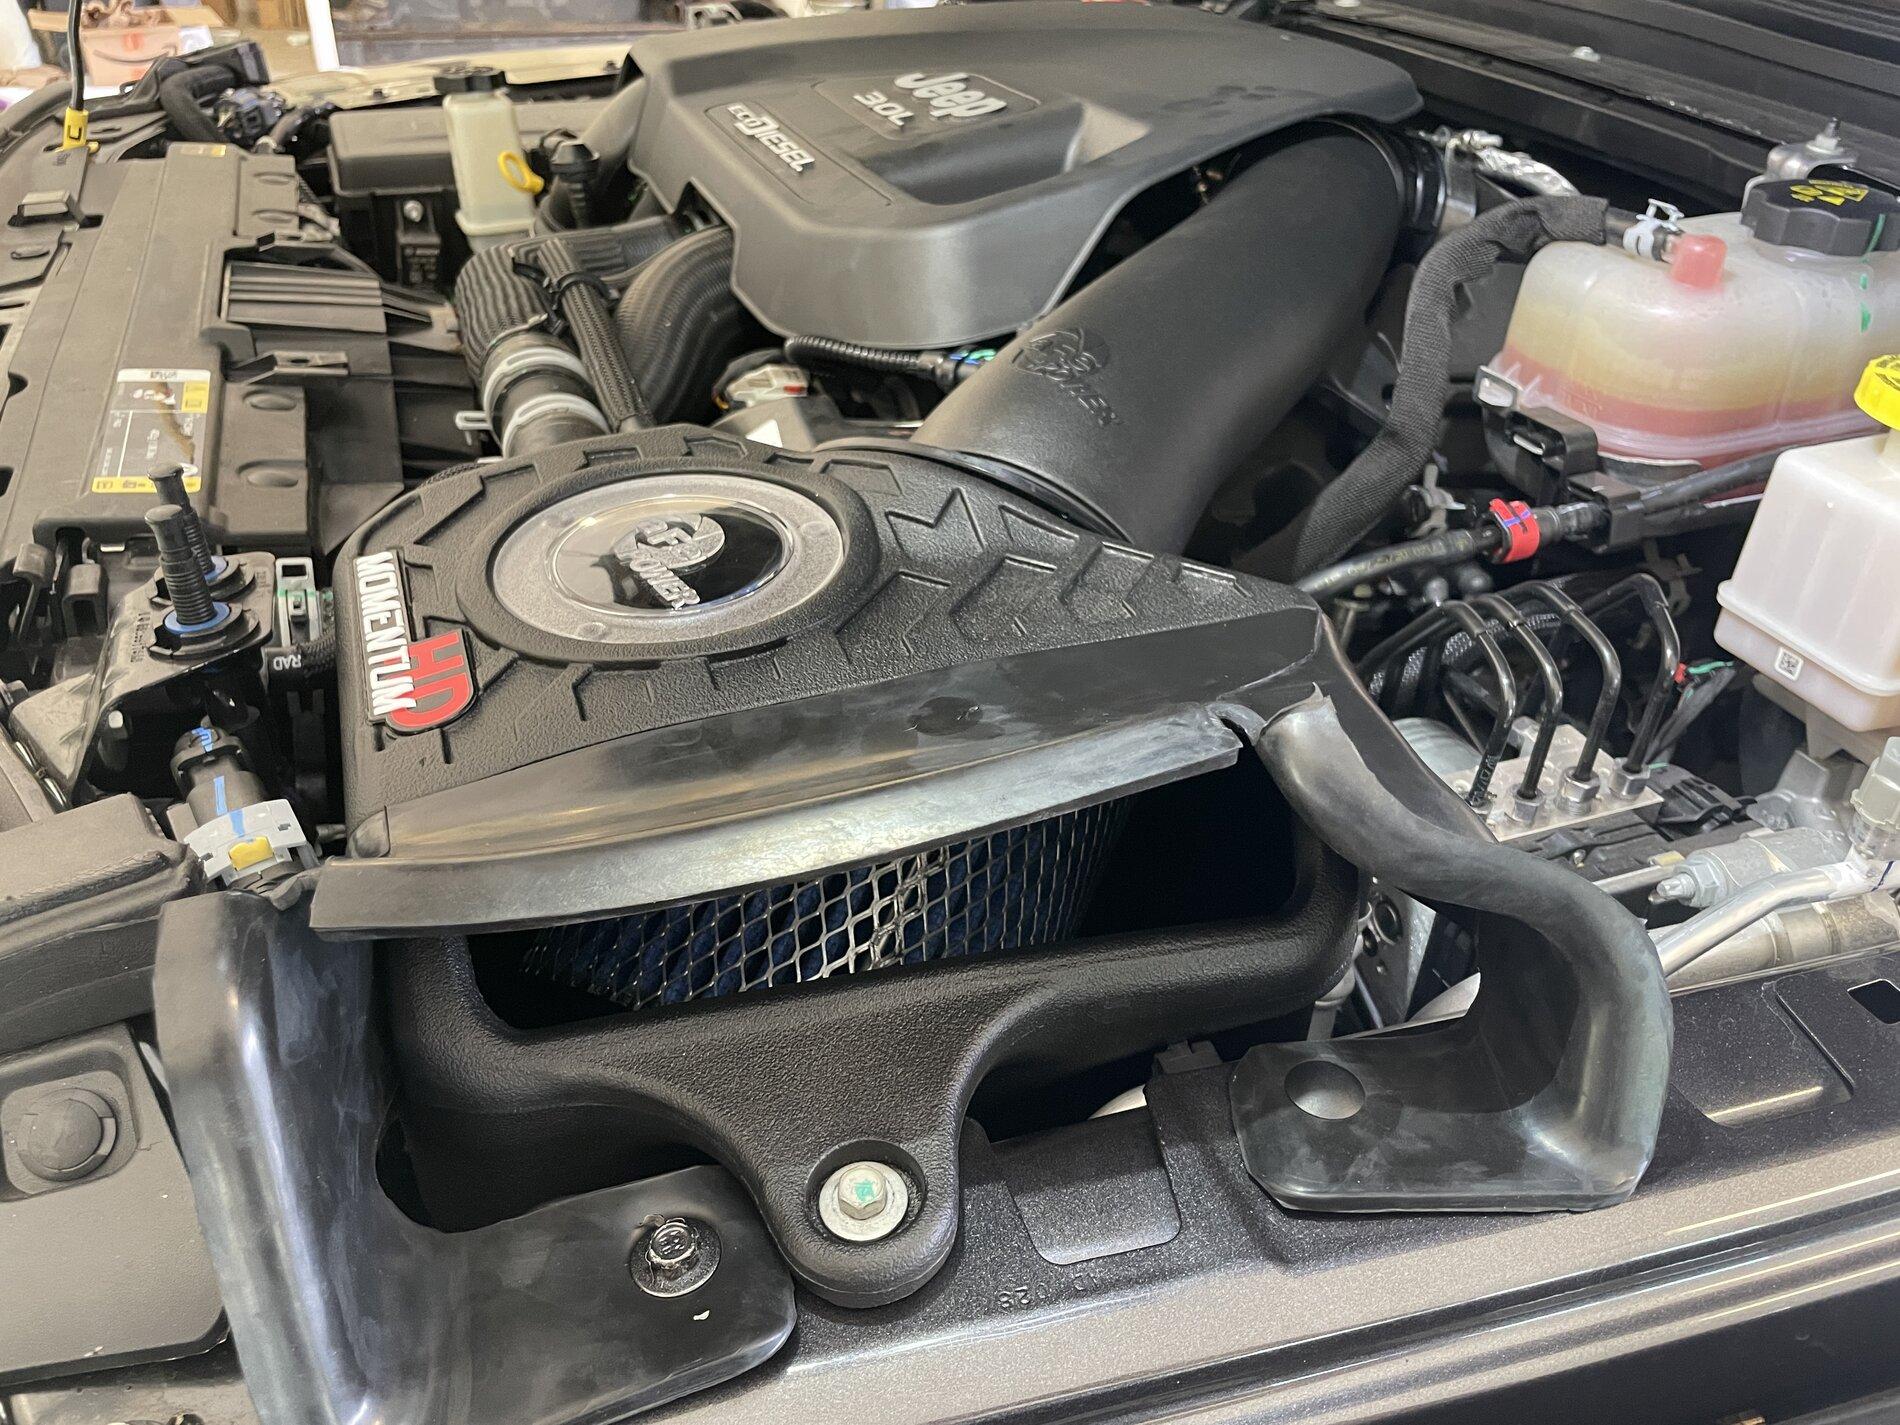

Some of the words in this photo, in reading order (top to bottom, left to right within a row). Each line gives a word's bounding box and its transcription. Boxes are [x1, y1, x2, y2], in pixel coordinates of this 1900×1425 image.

[894, 72, 1007, 118] Jeep
[622, 550, 700, 611] POWER
[273, 654, 302, 671] RAD
[356, 551, 417, 716] MOMENTUM
[386, 631, 469, 728] HD
